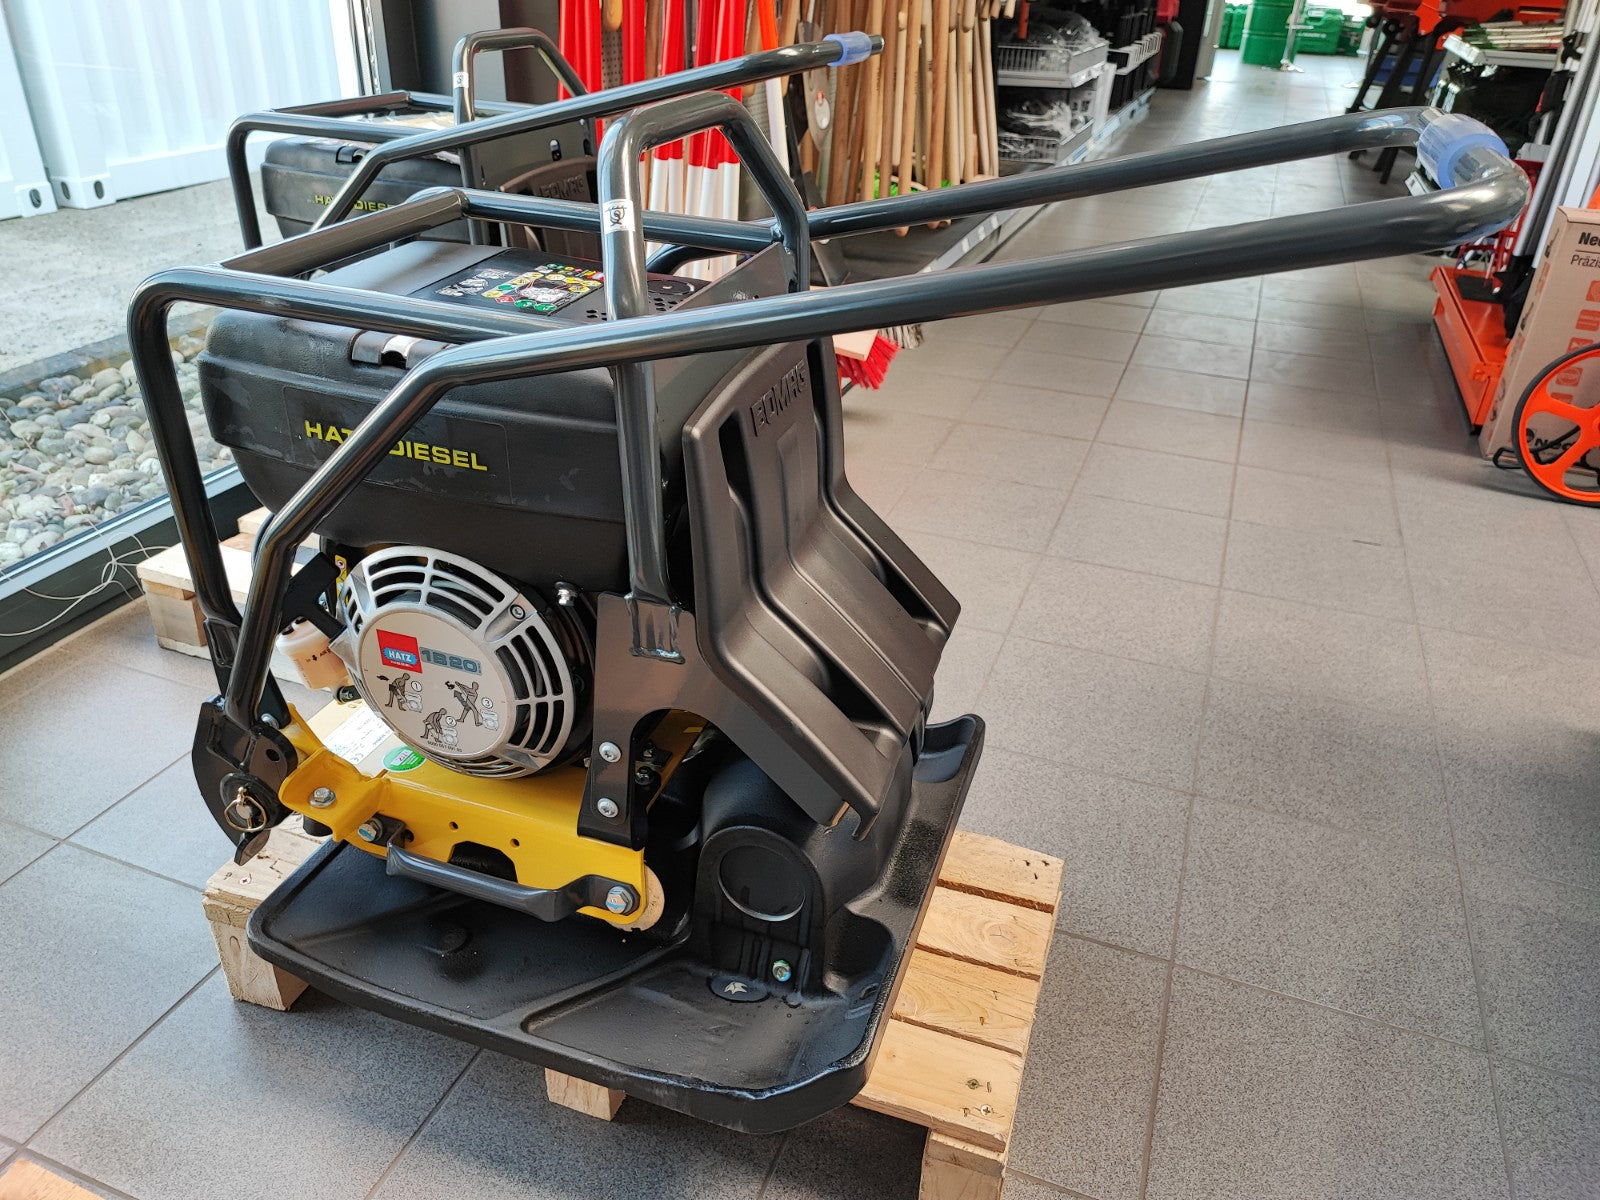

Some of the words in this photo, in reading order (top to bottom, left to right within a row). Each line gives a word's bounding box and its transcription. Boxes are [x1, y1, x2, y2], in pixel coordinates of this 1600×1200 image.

[354, 200, 396, 212] DIES
[1578, 231, 1600, 247] Ne
[304, 420, 353, 444] HAT
[389, 440, 488, 471] DIESEL
[388, 650, 412, 662] HATZ
[421, 650, 478, 673] 1B20
